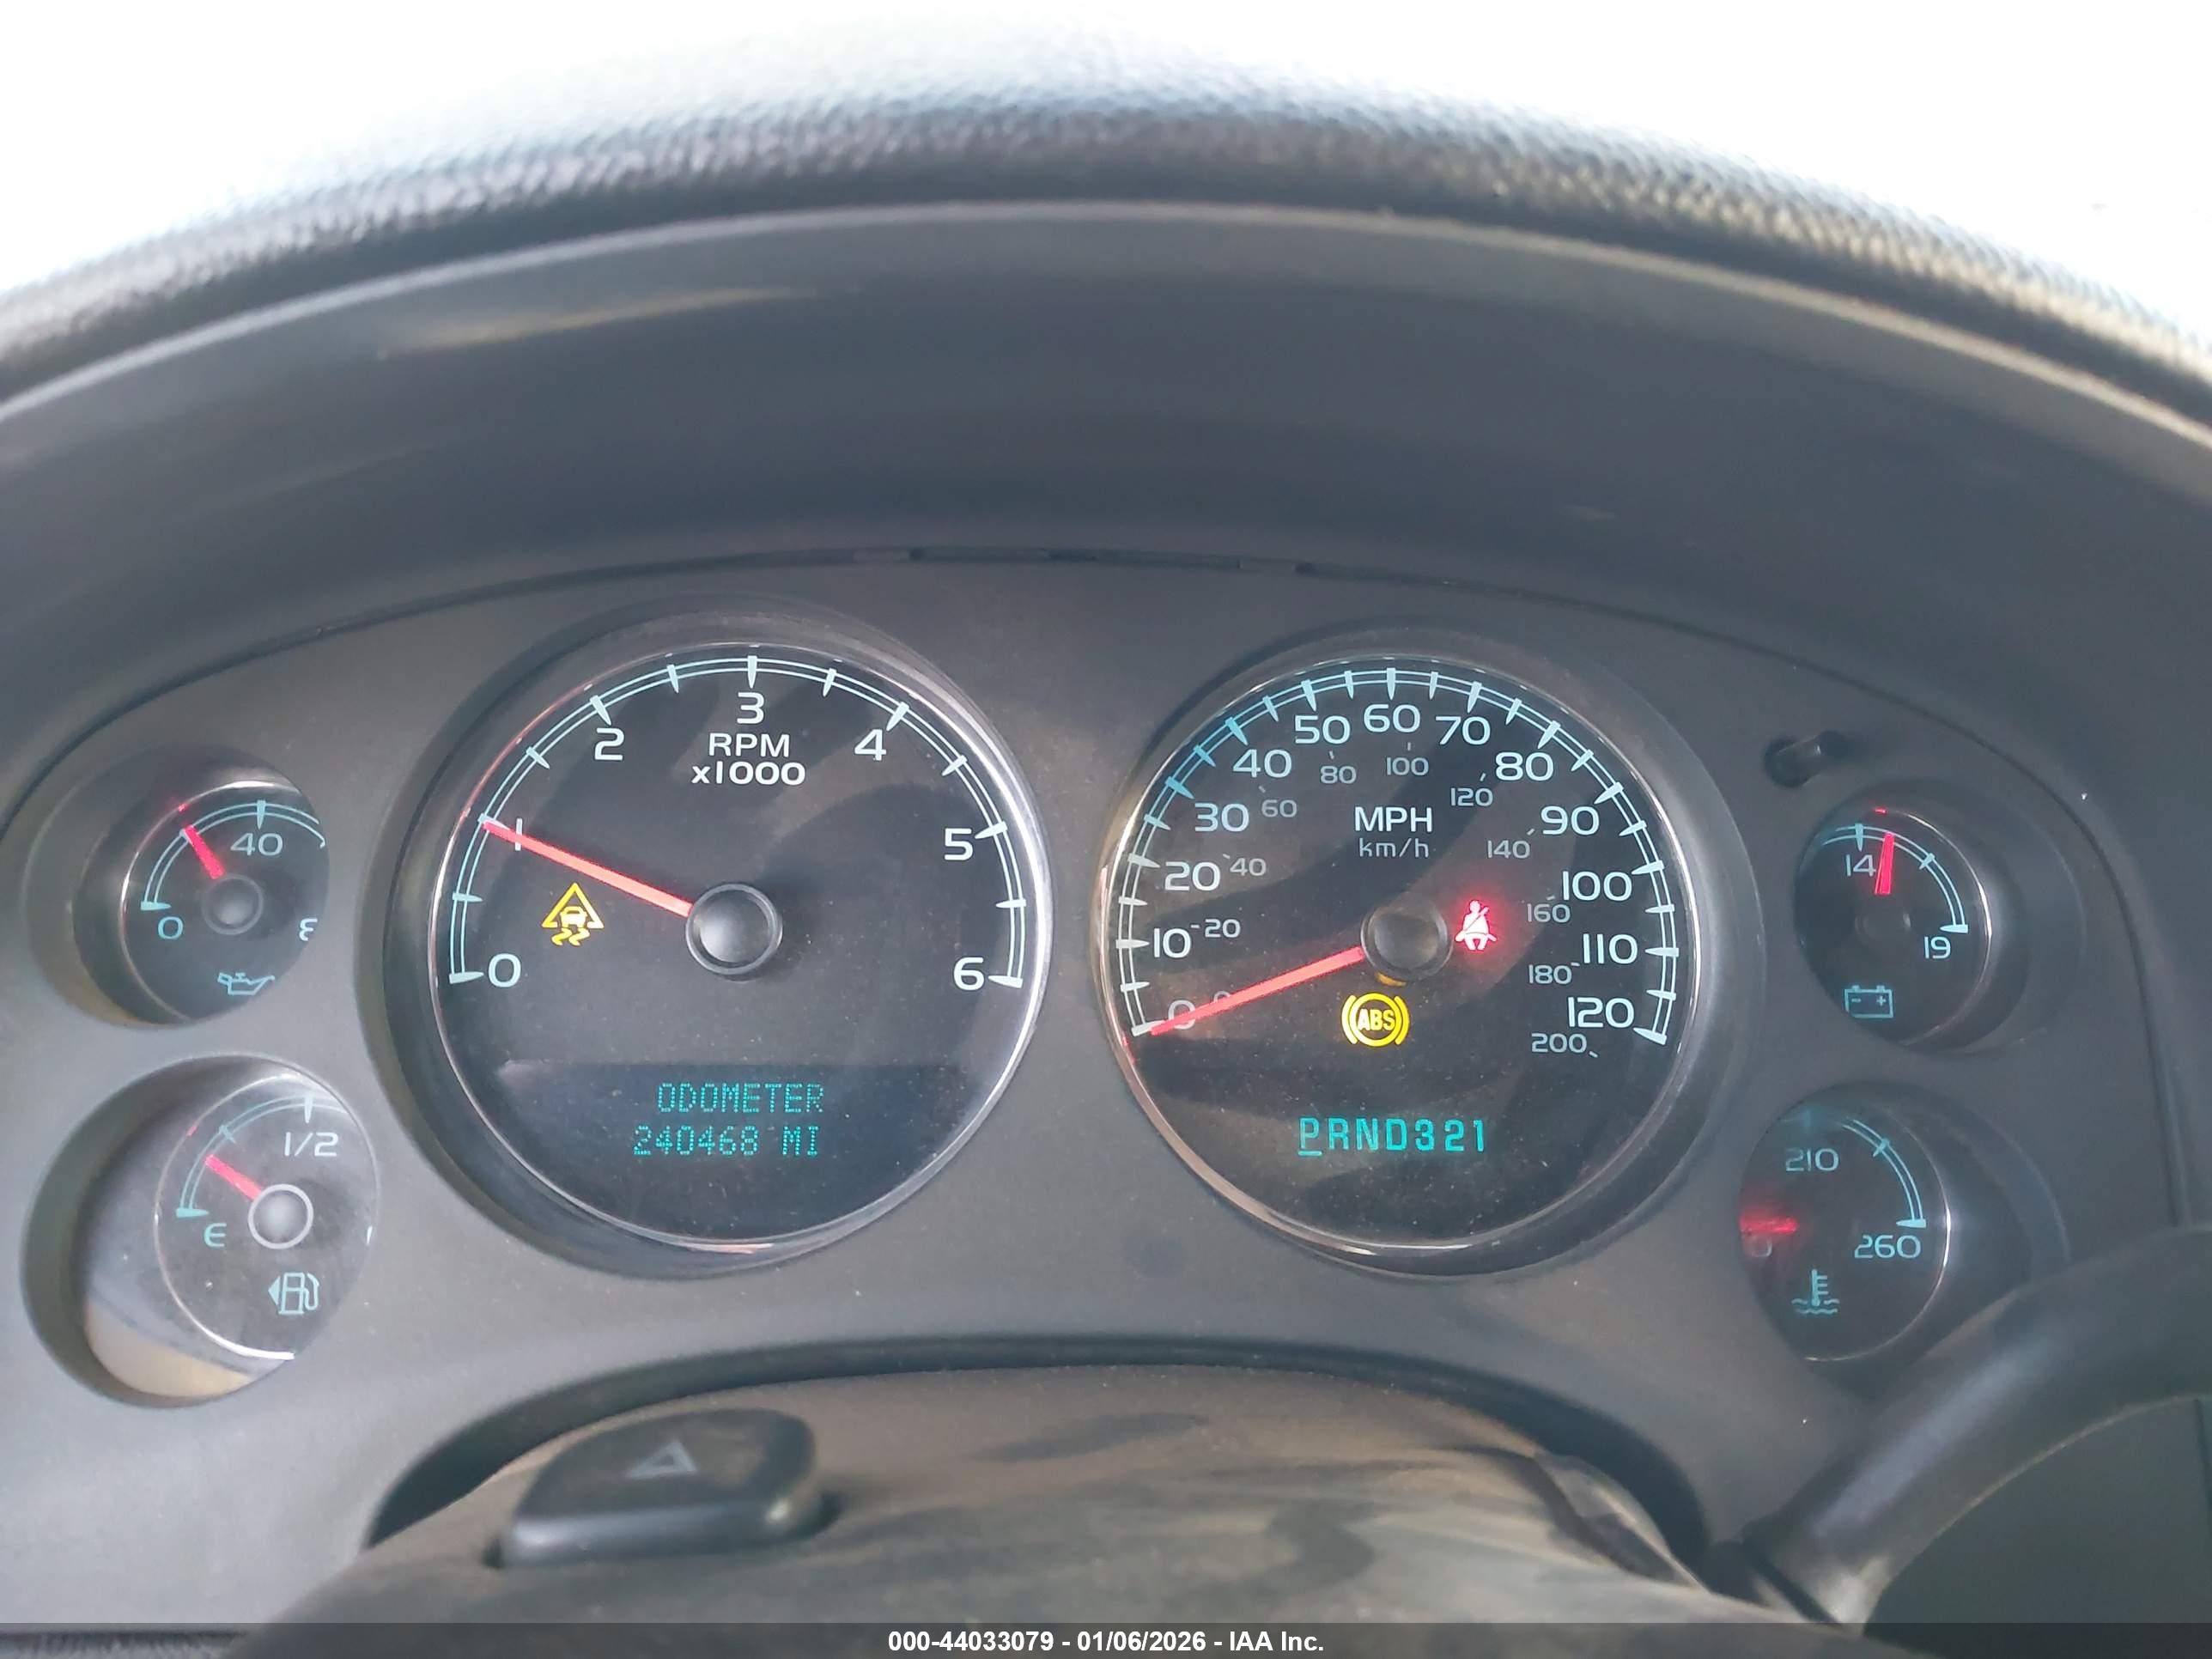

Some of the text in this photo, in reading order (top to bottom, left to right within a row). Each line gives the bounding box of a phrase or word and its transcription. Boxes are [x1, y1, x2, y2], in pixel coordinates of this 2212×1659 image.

[737, 692, 765, 725] 3
[1364, 704, 1420, 733] 60
[1295, 715, 1351, 744] 50
[1436, 716, 1492, 745] 70
[594, 727, 624, 761] 2
[708, 733, 790, 758] RPM
[854, 729, 887, 762] 4
[690, 762, 806, 787] x1000
[1232, 749, 1292, 778] 40
[1320, 765, 1357, 785] 80
[1386, 757, 1429, 776] 100
[1495, 752, 1554, 781] 80
[1261, 799, 1297, 817] 60
[1449, 787, 1493, 807] 120
[1194, 802, 1249, 832] 30
[1355, 806, 1432, 832] MPH
[1540, 805, 1600, 836] 90
[230, 833, 284, 857] 40
[944, 828, 975, 861] 5
[1359, 837, 1430, 858] km/h
[1487, 840, 1530, 859] 140
[1164, 861, 1221, 891] 20
[1230, 859, 1267, 877] 40
[1846, 854, 1876, 877] 14
[1562, 871, 1632, 902] 100
[1527, 903, 1571, 923] 160
[157, 916, 184, 940] 0
[1204, 919, 1242, 939] 20
[1153, 927, 1192, 959] 10
[1583, 933, 1638, 964] 110
[1923, 936, 1952, 959] 19
[488, 953, 522, 988] 0
[953, 957, 986, 991] 6
[1528, 965, 1573, 985] 180
[1357, 1008, 1396, 1030] ABS
[1568, 996, 1634, 1029] 120
[1531, 1033, 1587, 1054] 200
[657, 1082, 824, 1113] ODOMETER
[283, 1132, 339, 1158] 1/2
[632, 1125, 821, 1156] 240468 MI
[1785, 1148, 1839, 1172] 210
[204, 1223, 228, 1247] E
[1854, 1235, 1922, 1260] 260
